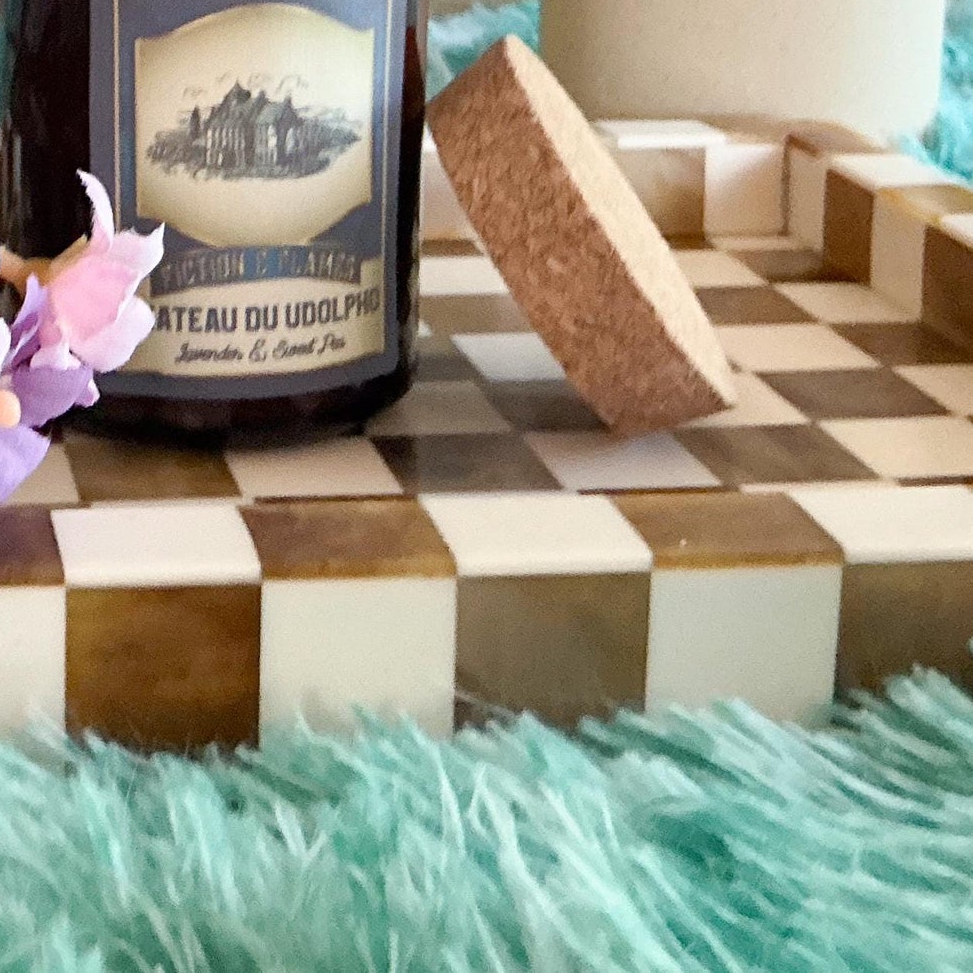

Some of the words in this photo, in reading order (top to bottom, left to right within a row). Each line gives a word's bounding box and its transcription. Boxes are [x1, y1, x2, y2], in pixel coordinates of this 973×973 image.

[150, 305, 238, 333] ATEAU
[244, 305, 279, 333] DU
[248, 338, 267, 362] &
